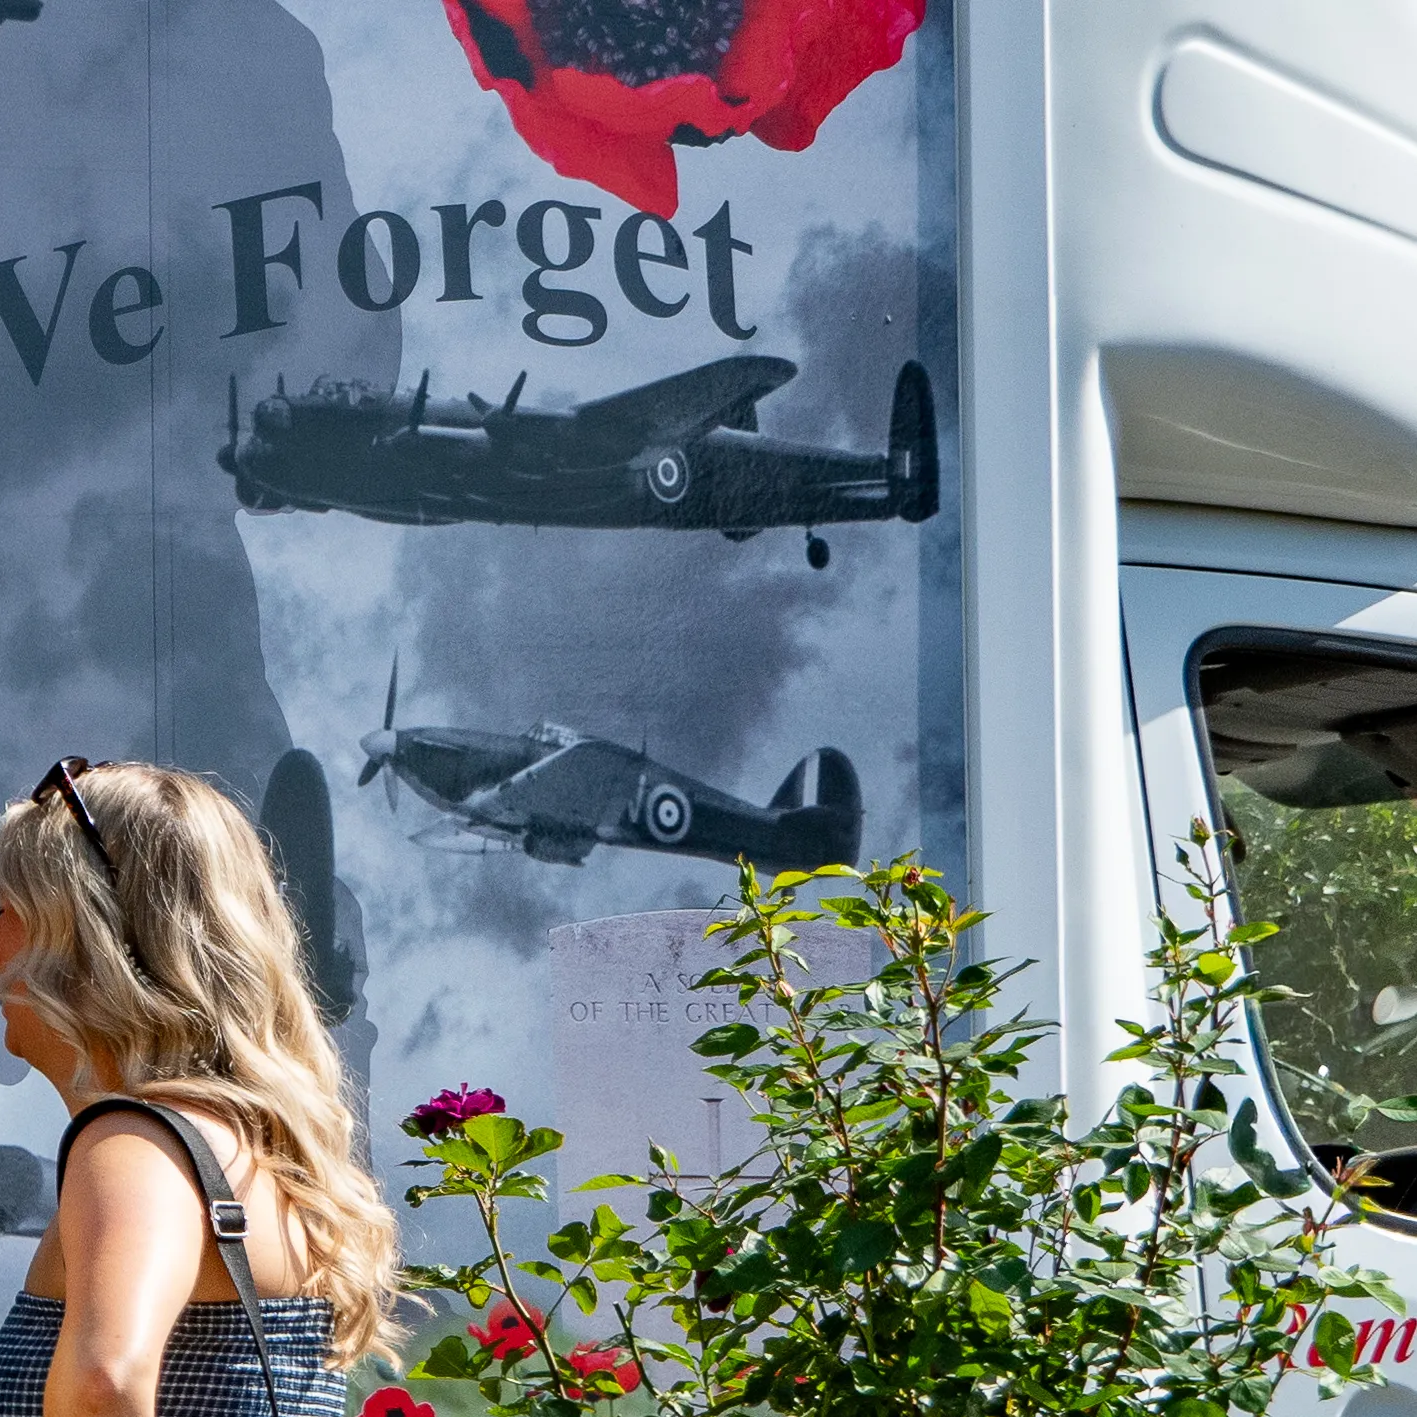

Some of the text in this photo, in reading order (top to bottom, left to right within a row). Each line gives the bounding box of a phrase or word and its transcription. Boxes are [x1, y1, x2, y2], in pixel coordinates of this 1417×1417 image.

[211, 180, 758, 347] Forget
[570, 1001, 775, 1024] OF THE GREAT
